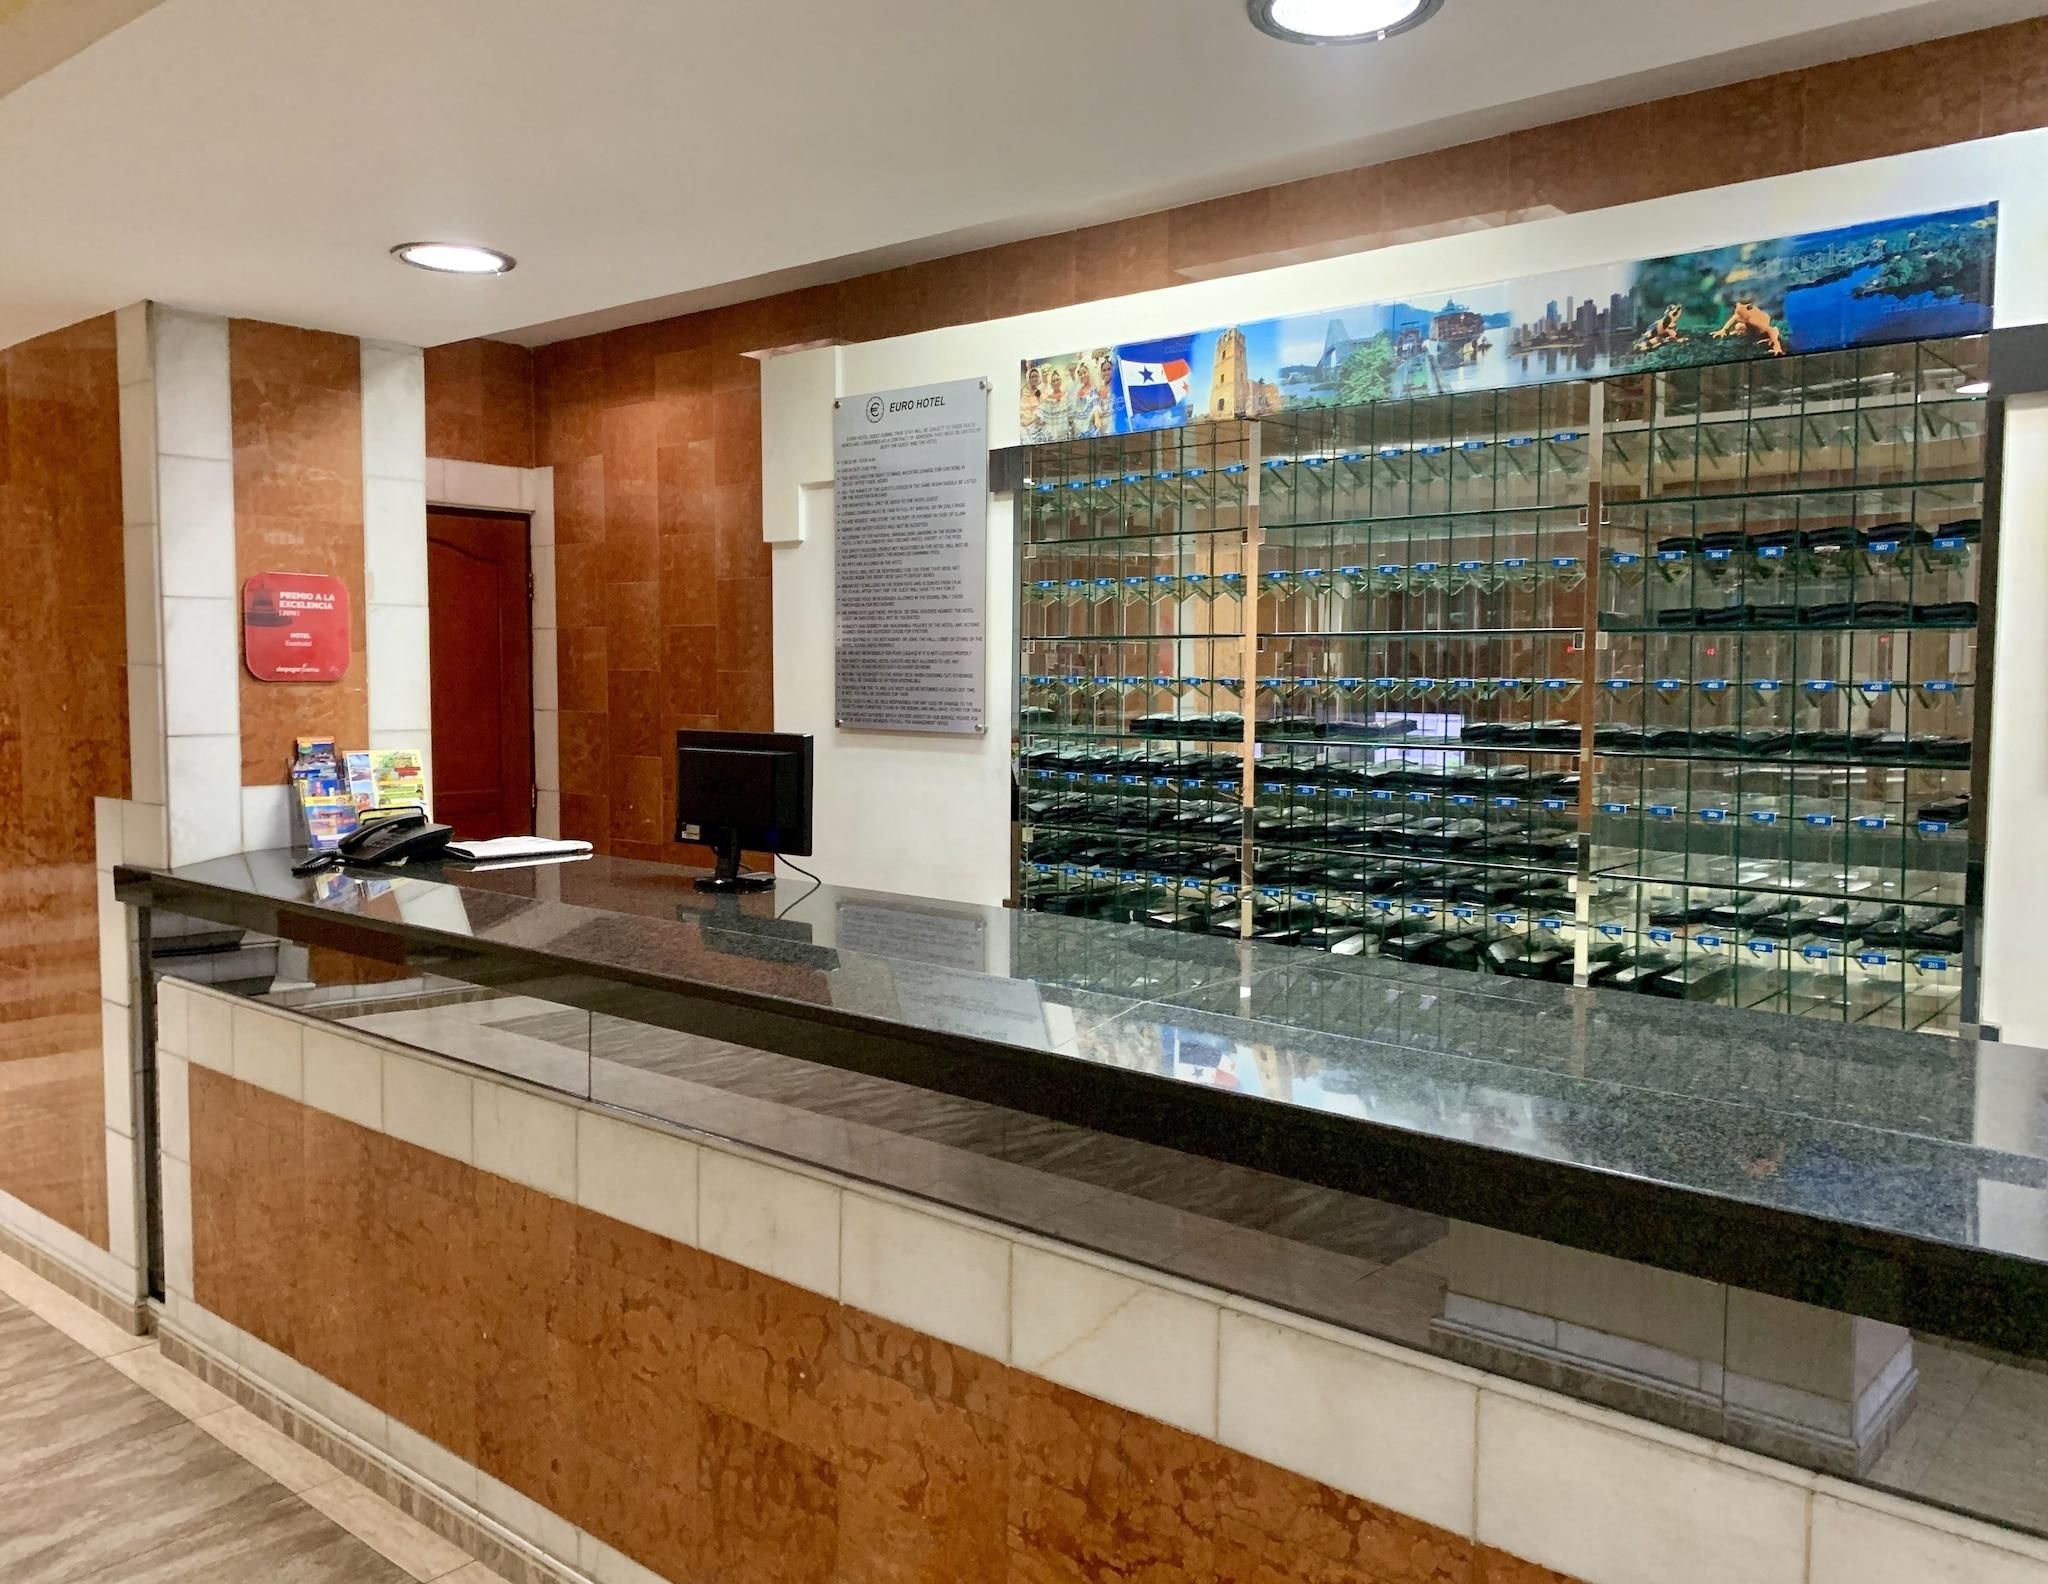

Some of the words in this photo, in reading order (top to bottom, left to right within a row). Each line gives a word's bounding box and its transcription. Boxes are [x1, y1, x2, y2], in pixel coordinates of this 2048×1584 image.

[1749, 242, 1884, 275] aturaleza
[889, 399, 914, 413] EURO
[916, 395, 946, 409] HOTEL
[279, 591, 313, 600] PREMIO
[315, 593, 322, 601] A
[323, 593, 336, 602] LA
[279, 600, 335, 610] EXCELENCIA
